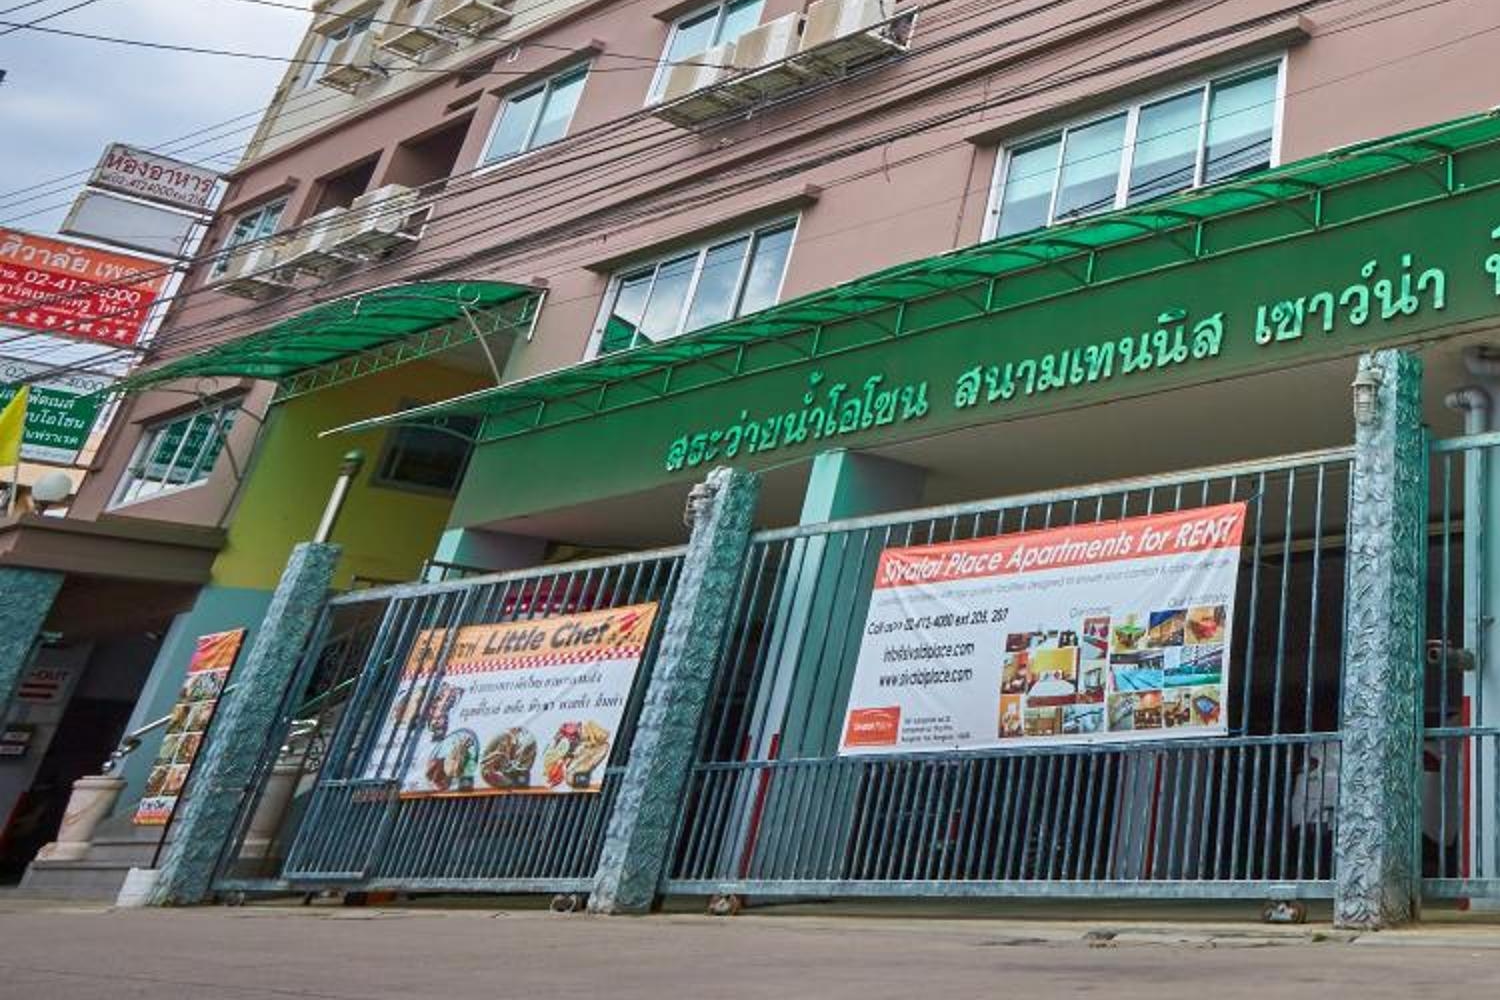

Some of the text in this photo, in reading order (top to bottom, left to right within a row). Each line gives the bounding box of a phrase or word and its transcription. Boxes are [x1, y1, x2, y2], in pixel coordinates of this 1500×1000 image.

[104, 150, 213, 193] ห้องอาหาร
[0, 234, 91, 274] ศิวาลัย
[665, 370, 930, 472] สระว่ายน้ำโอโซน
[954, 309, 1225, 408] สนามเทนนิส
[1254, 254, 1447, 345] เซาว์น่า
[943, 551, 1003, 577] Place
[1005, 531, 1134, 573] Apartments
[1136, 526, 1172, 554] for
[1173, 515, 1237, 548] RENT
[483, 626, 546, 656] Little
[551, 615, 613, 650] Chef
